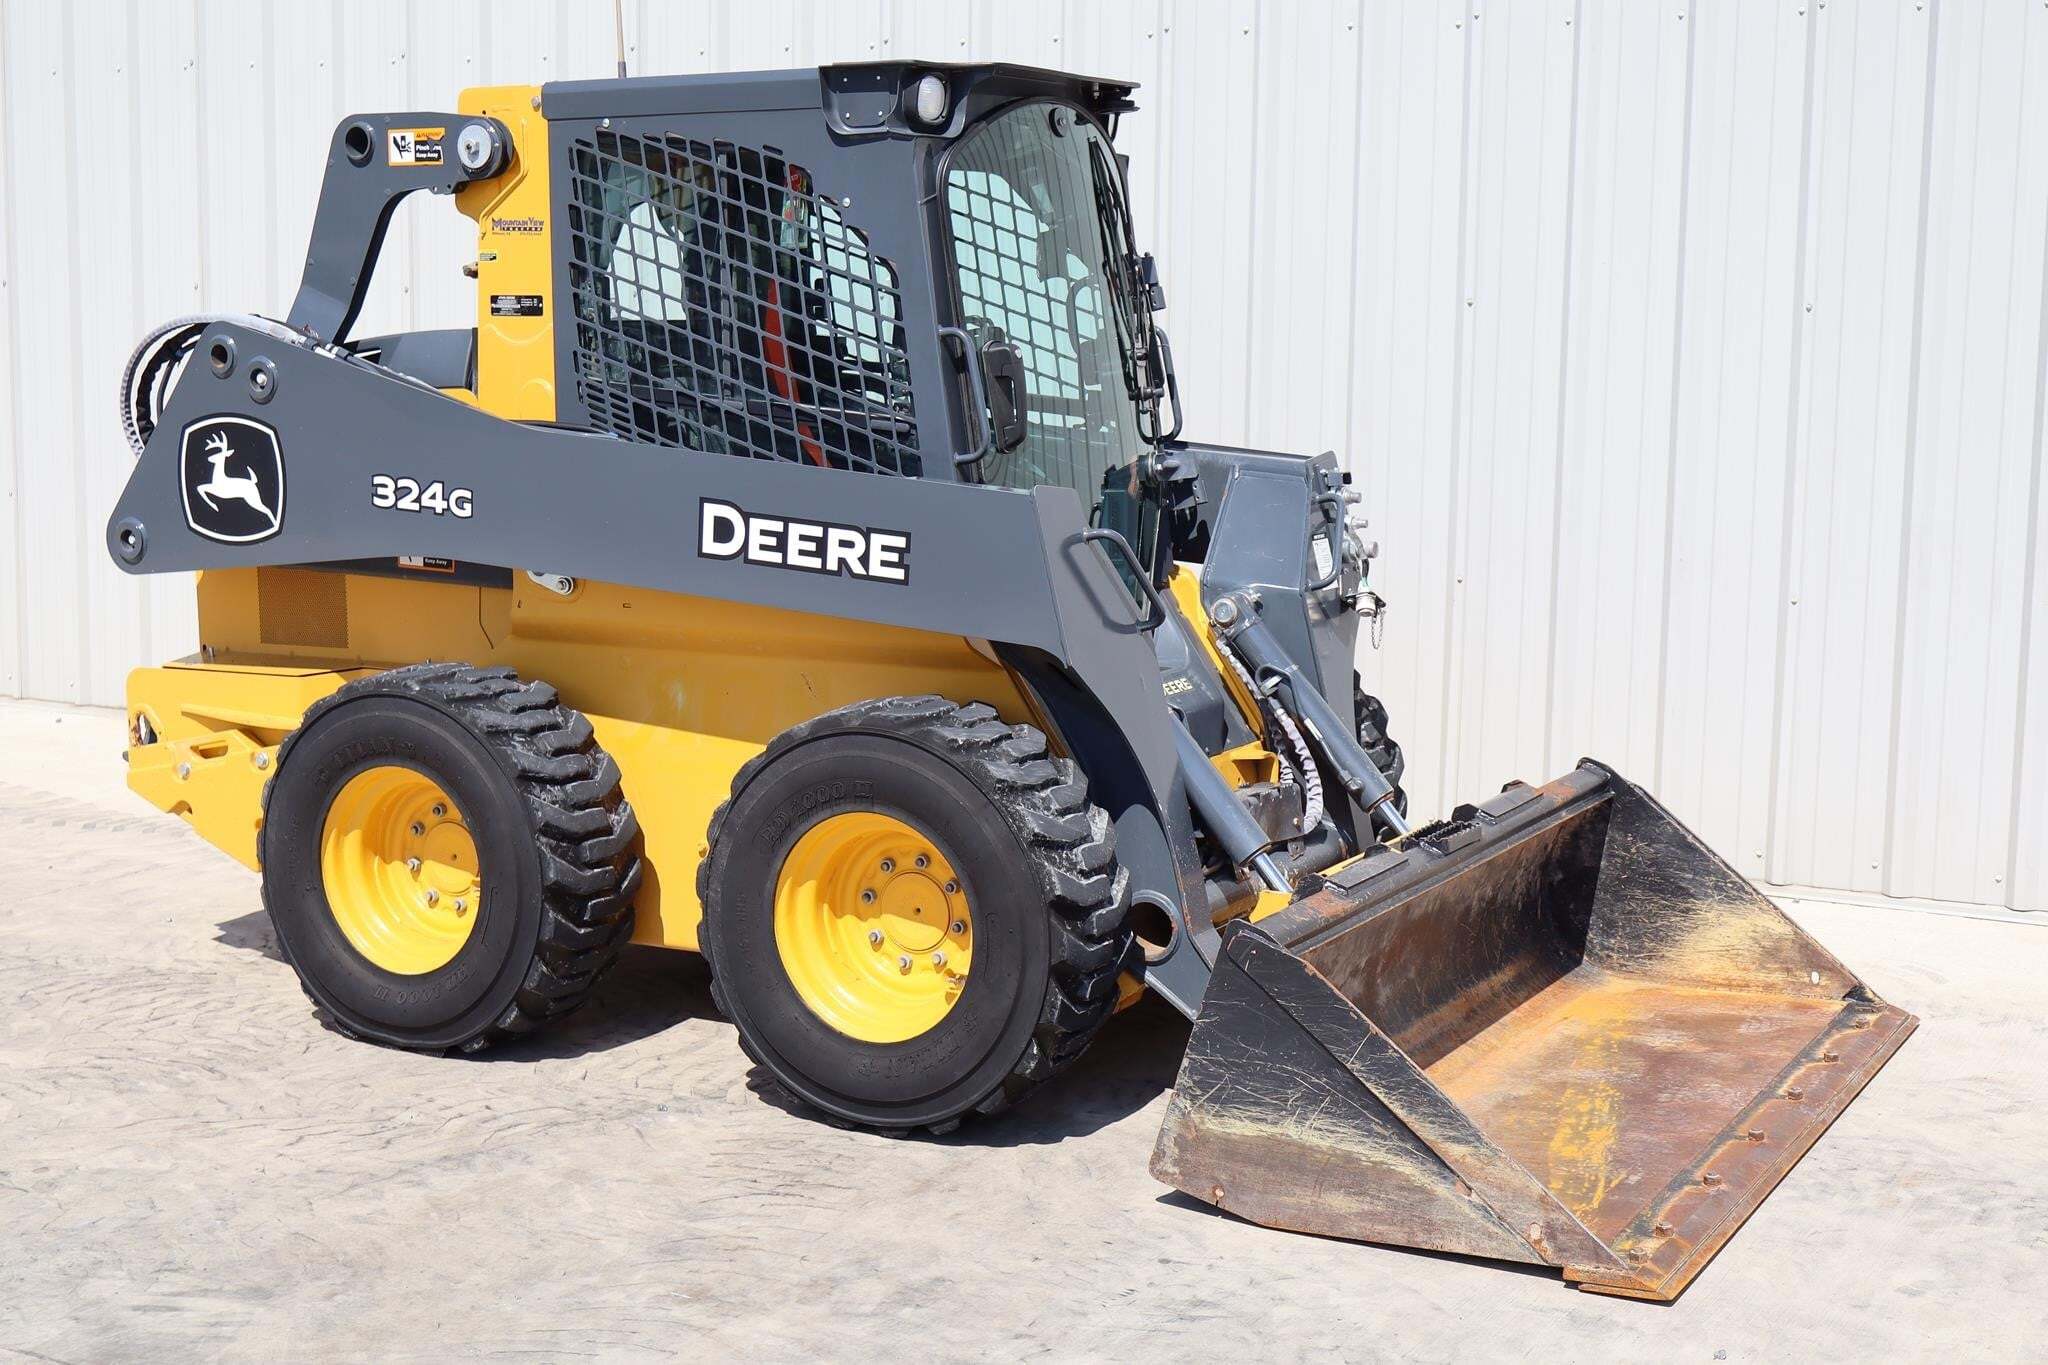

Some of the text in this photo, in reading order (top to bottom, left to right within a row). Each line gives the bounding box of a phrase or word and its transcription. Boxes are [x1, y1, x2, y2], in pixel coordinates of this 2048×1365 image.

[372, 474, 473, 518] 324G
[700, 499, 909, 583] DEERE
[1162, 678, 1193, 697] EERE
